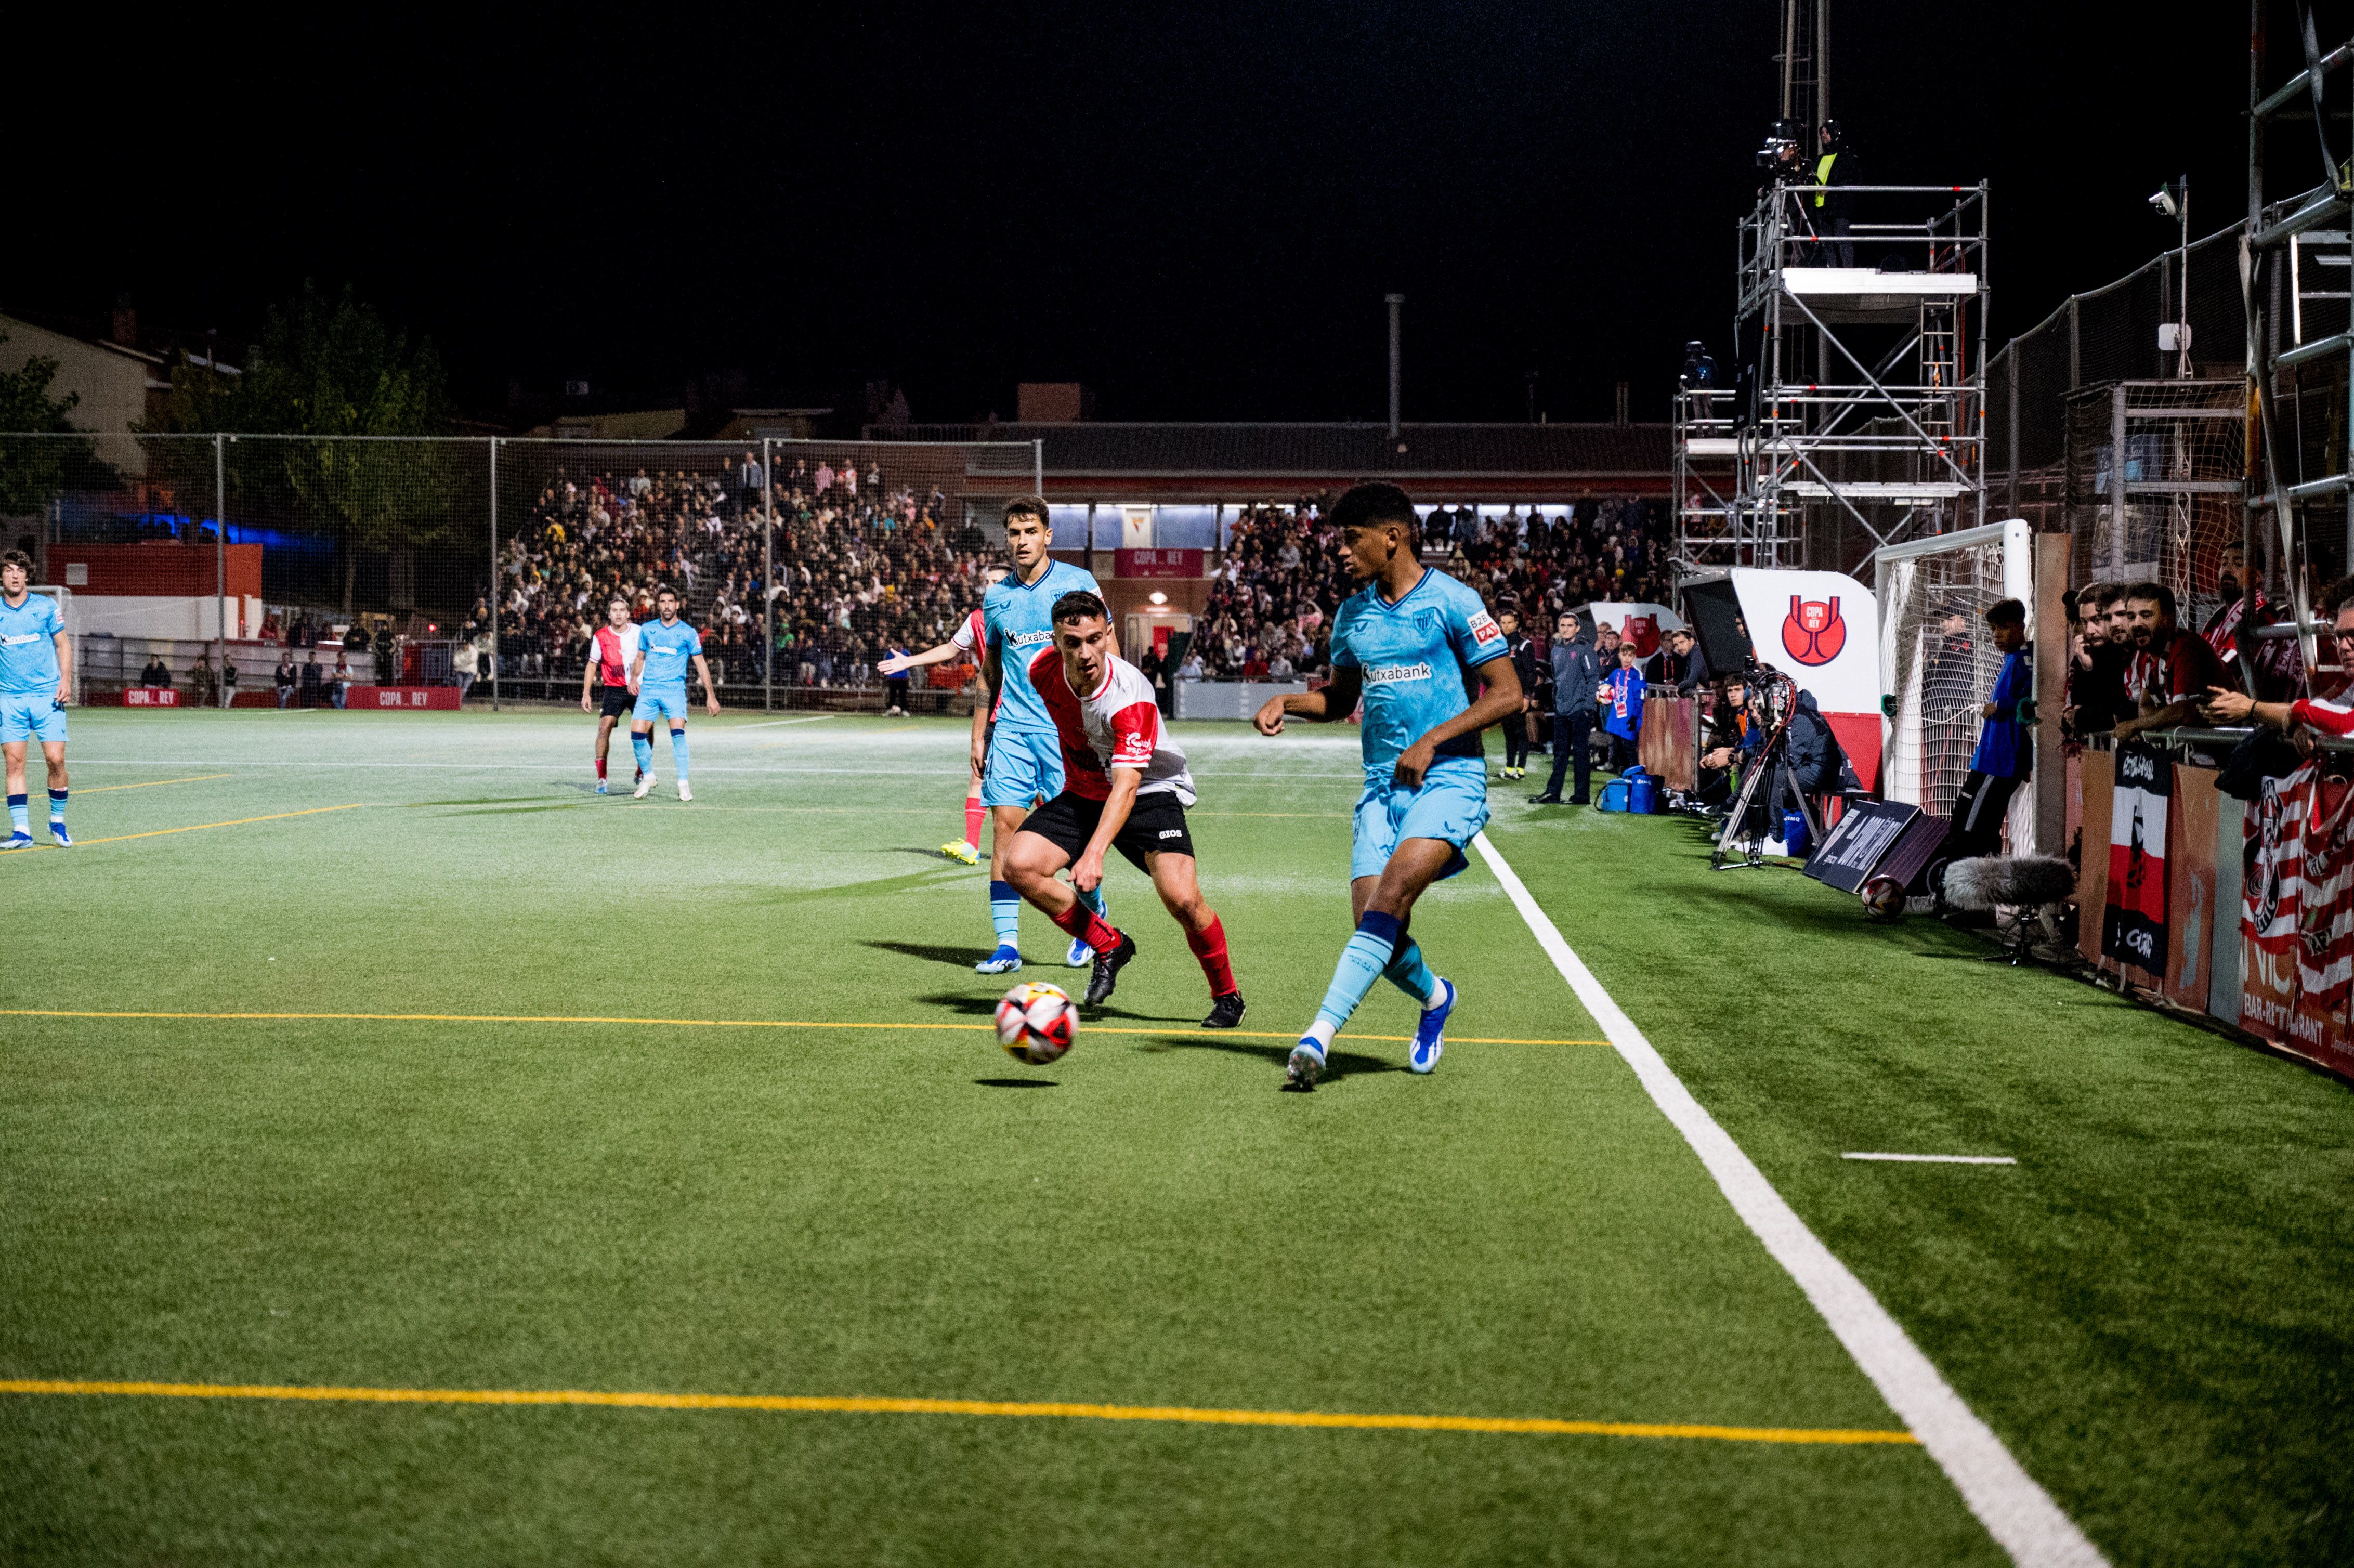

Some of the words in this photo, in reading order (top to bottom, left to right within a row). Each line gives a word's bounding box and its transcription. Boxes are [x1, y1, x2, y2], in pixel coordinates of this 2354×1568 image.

[1134, 551, 1156, 565] COPA
[1167, 551, 1183, 565] REY
[1807, 607, 1823, 617] COPA
[1470, 615, 1487, 628] B2B
[1809, 619, 1820, 628] REY
[1005, 629, 1054, 646] Kutxaba
[1363, 664, 1430, 683] Kutxabank
[129, 690, 149, 704] COPA
[159, 691, 174, 704] REY
[380, 692, 401, 706] COPA
[412, 692, 427, 706] REY
[1159, 830, 1182, 840] GIOS
